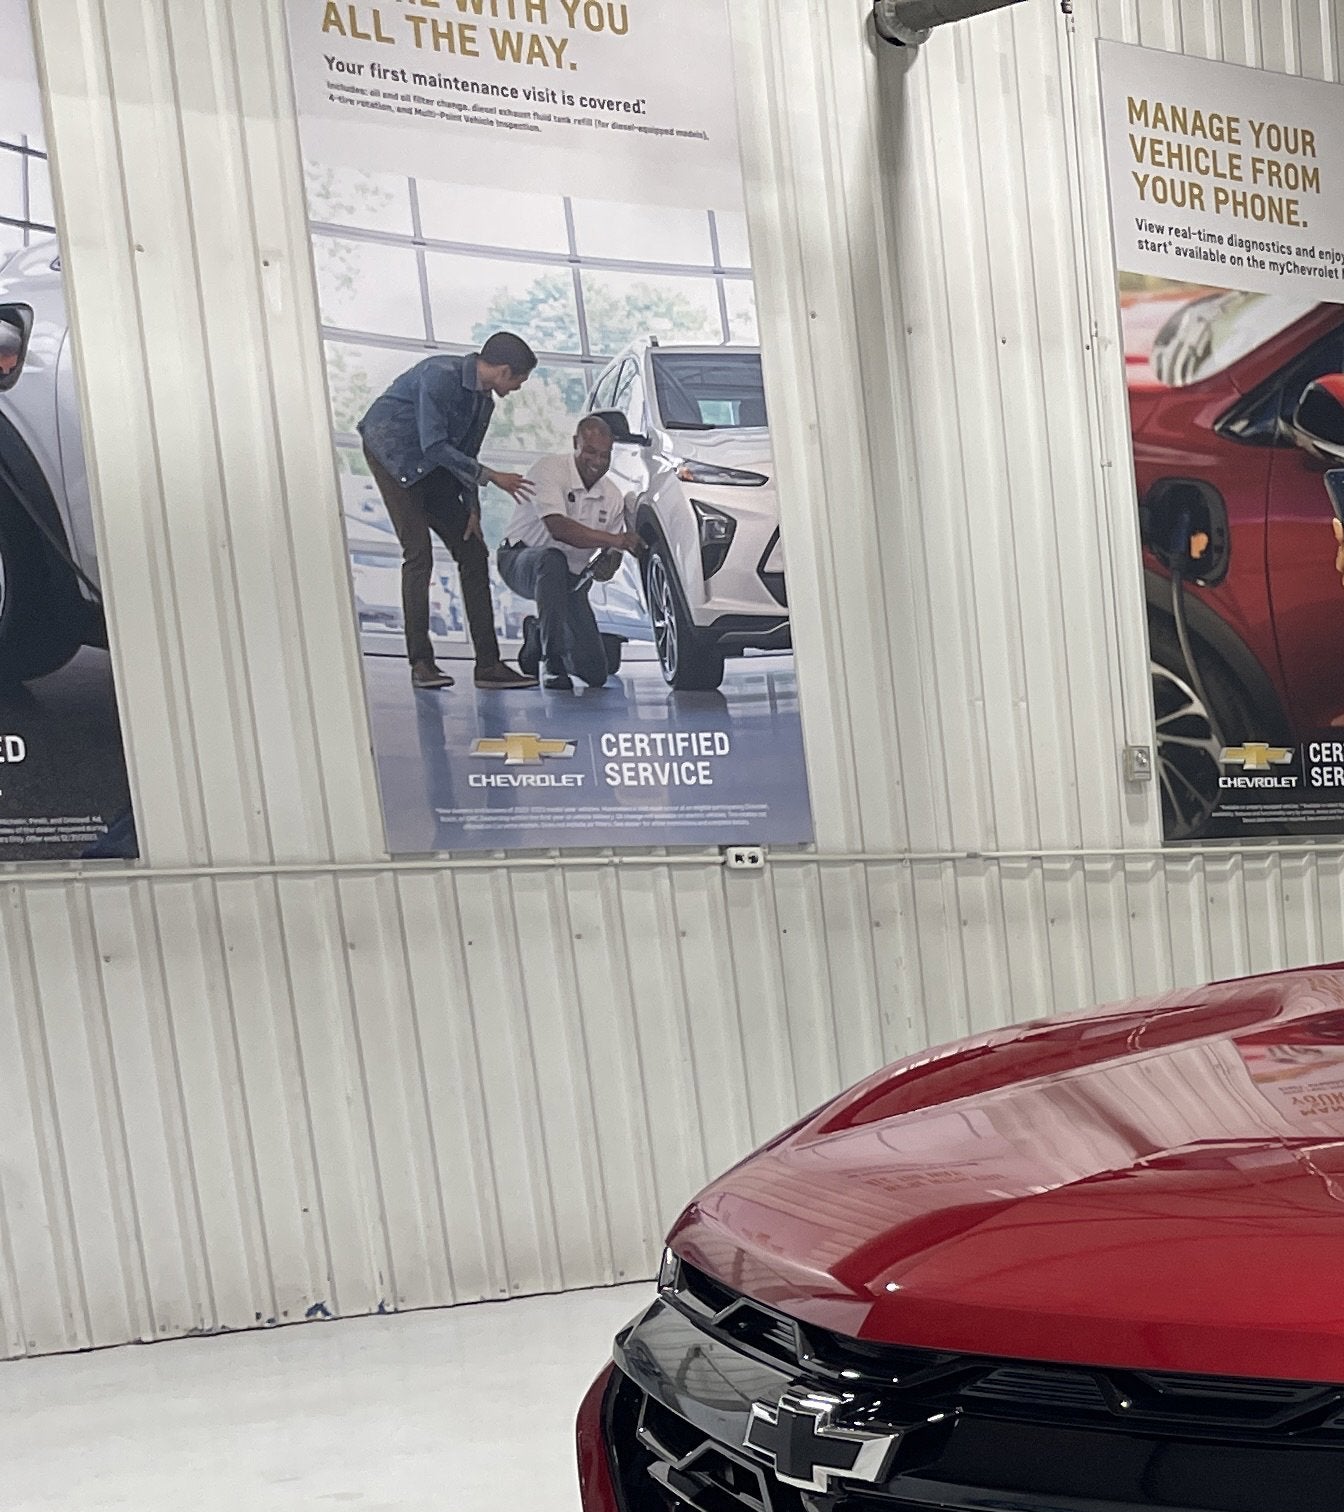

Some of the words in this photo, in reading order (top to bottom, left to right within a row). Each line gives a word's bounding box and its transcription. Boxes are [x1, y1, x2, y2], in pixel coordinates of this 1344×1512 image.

[321, 1, 395, 45] ALL
[405, 14, 480, 57] THE
[489, 27, 579, 71] WAY.
[561, 0, 629, 35] YOU
[324, 54, 365, 76] Your
[371, 63, 408, 84] first
[412, 71, 518, 100] maintenance
[523, 86, 557, 105] visit
[561, 89, 574, 106] is
[1127, 96, 1242, 146] MANAGE
[1248, 119, 1317, 158] YOUR
[1129, 133, 1243, 183] VEHICLE
[1251, 156, 1321, 194] FROM
[1131, 170, 1206, 212] YOUR
[1213, 186, 1309, 228] PHONE.
[1135, 217, 1165, 235] View
[1168, 225, 1224, 246] real-time
[1227, 233, 1292, 257] diagnostics
[1295, 244, 1316, 259] and
[1175, 245, 1226, 265] available
[1229, 254, 1244, 267] on
[1246, 256, 1266, 270] the
[1269, 260, 1339, 281] myChevrolet
[601, 732, 730, 757] CERTIFIED
[468, 774, 585, 787] CHEVROLET
[605, 761, 713, 786] SERVICE
[1218, 776, 1298, 788] CHEVROLET
